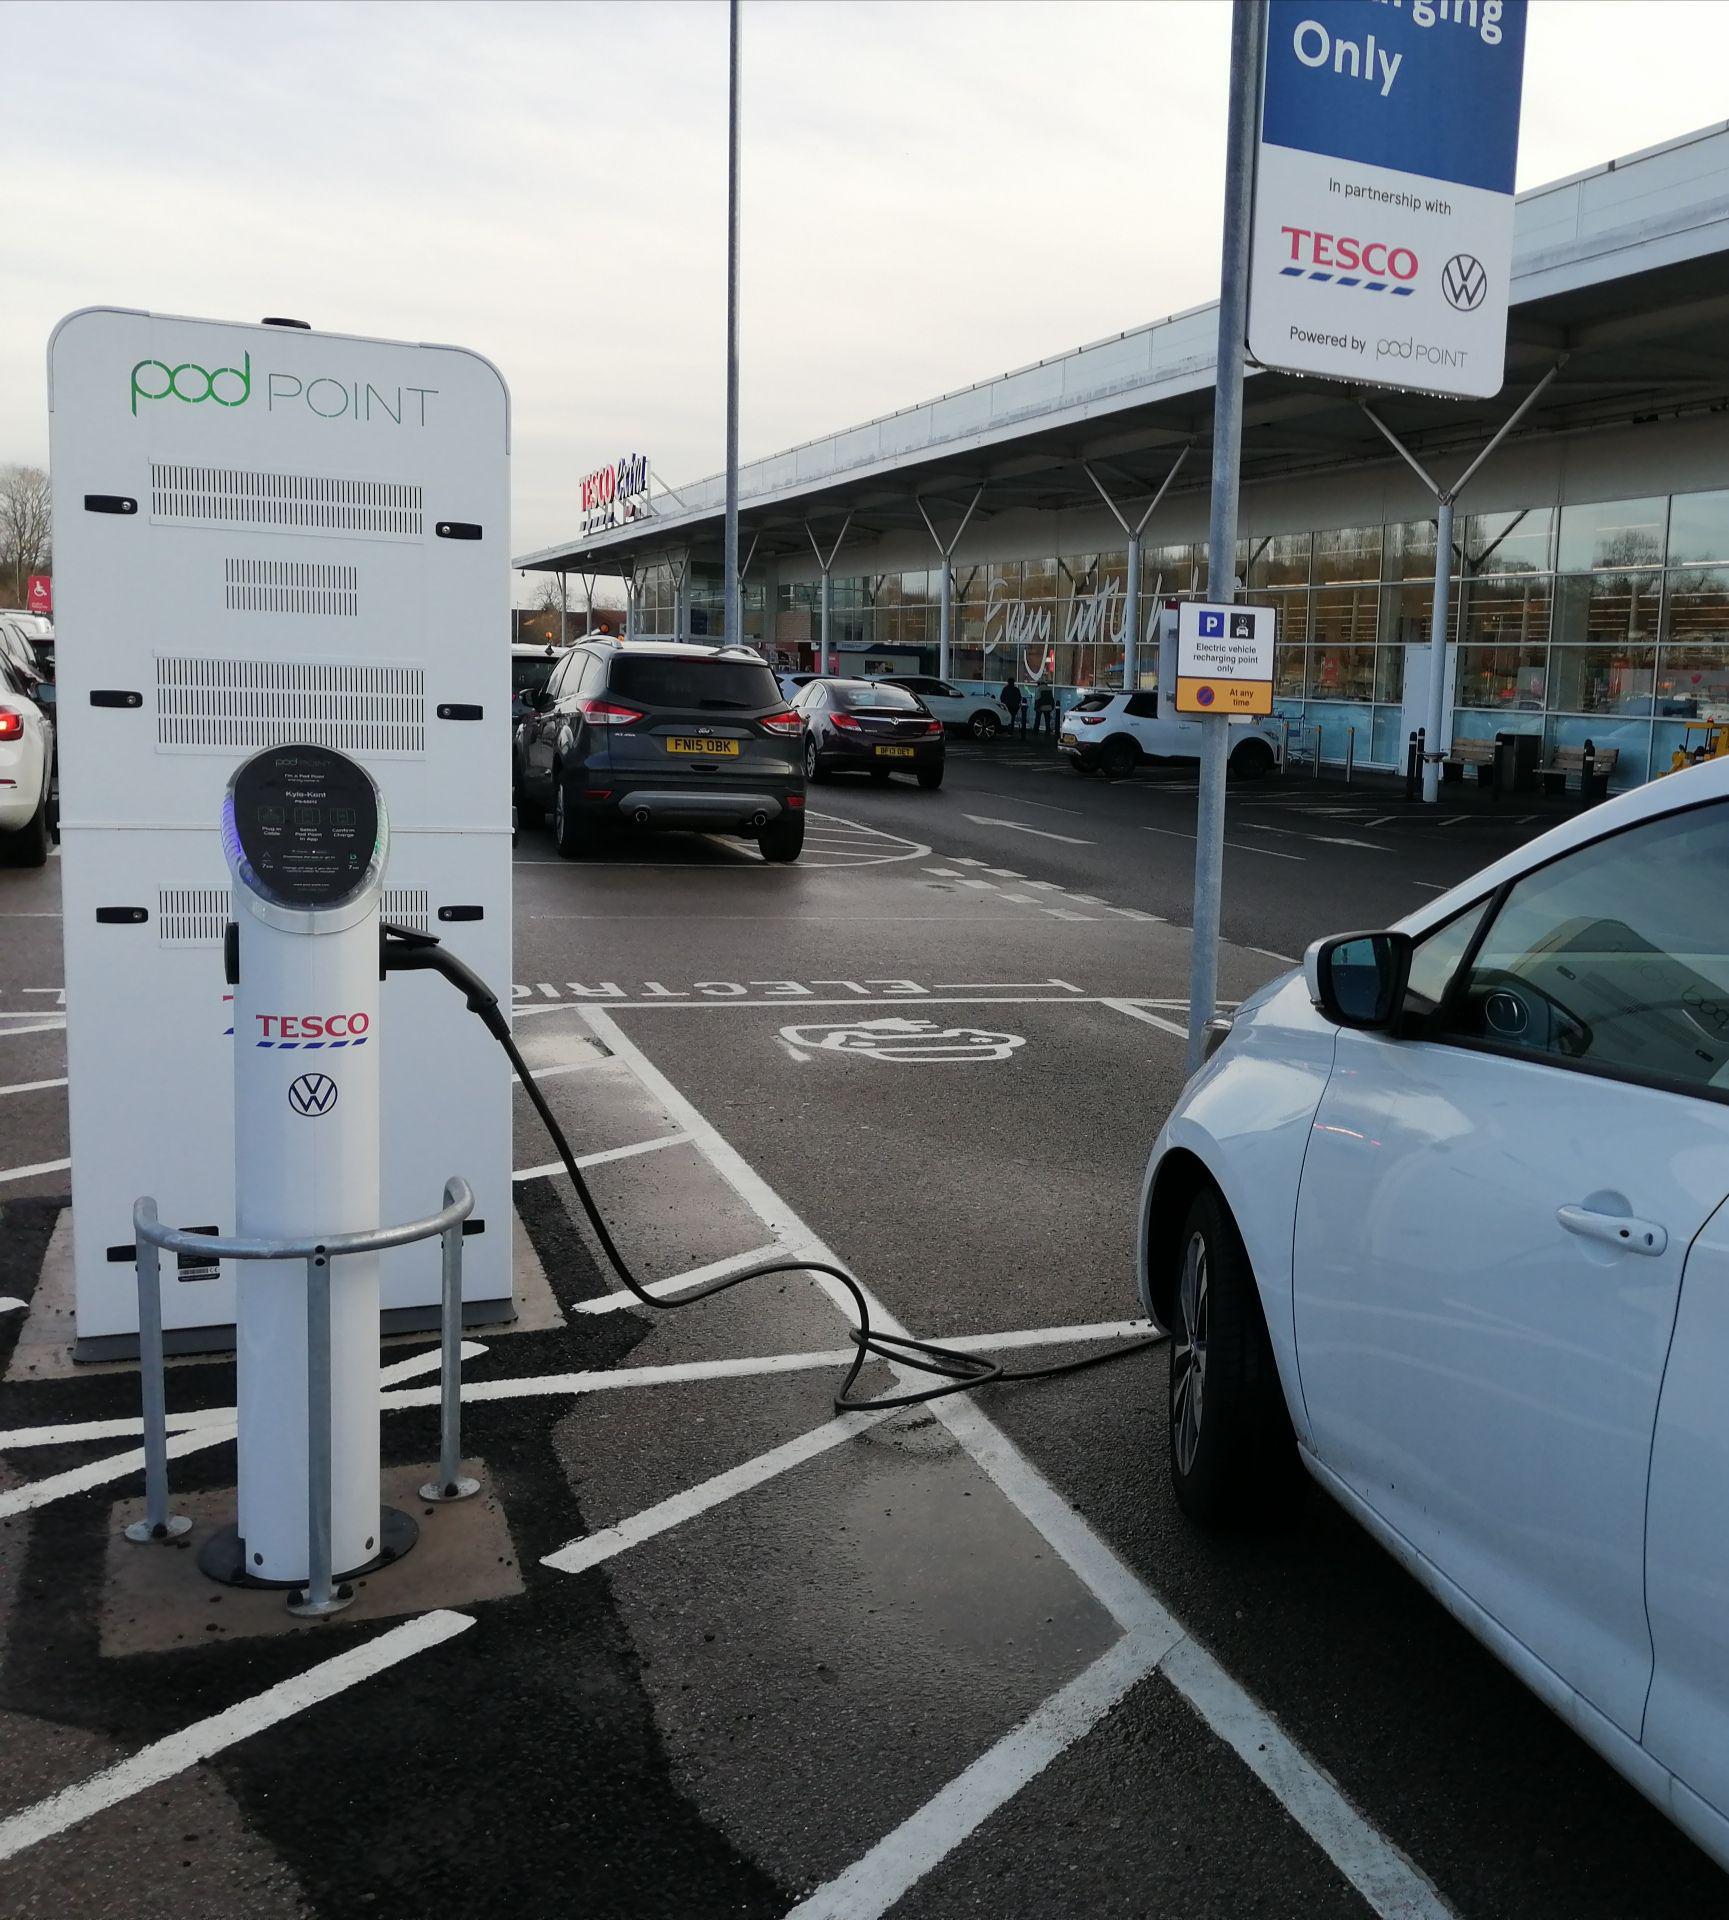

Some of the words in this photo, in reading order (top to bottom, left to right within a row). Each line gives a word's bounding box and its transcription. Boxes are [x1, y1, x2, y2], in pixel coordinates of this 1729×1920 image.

[1293, 20, 1403, 97] Only
[1329, 177, 1341, 193] In
[1344, 182, 1421, 211] partnership
[1425, 197, 1452, 216] with
[1281, 225, 1418, 280] TESCO
[1289, 325, 1347, 349] Powered
[1351, 334, 1366, 354] by
[1376, 336, 1413, 361] pod
[1416, 344, 1468, 368] POINT
[131, 350, 251, 418] pod
[268, 372, 439, 427] POINT
[578, 463, 616, 512] TESCO
[1206, 616, 1218, 633] P
[1193, 653, 1236, 664] recharging
[1238, 655, 1258, 664] point
[1196, 643, 1226, 652] Electric
[1228, 644, 1256, 654] vehicle
[1217, 664, 1234, 674] only
[1229, 688, 1238, 697] At
[1240, 690, 1254, 698] any
[1233, 698, 1250, 706] time
[674, 739, 703, 750] FN15
[255, 1011, 370, 1039] TESCO
